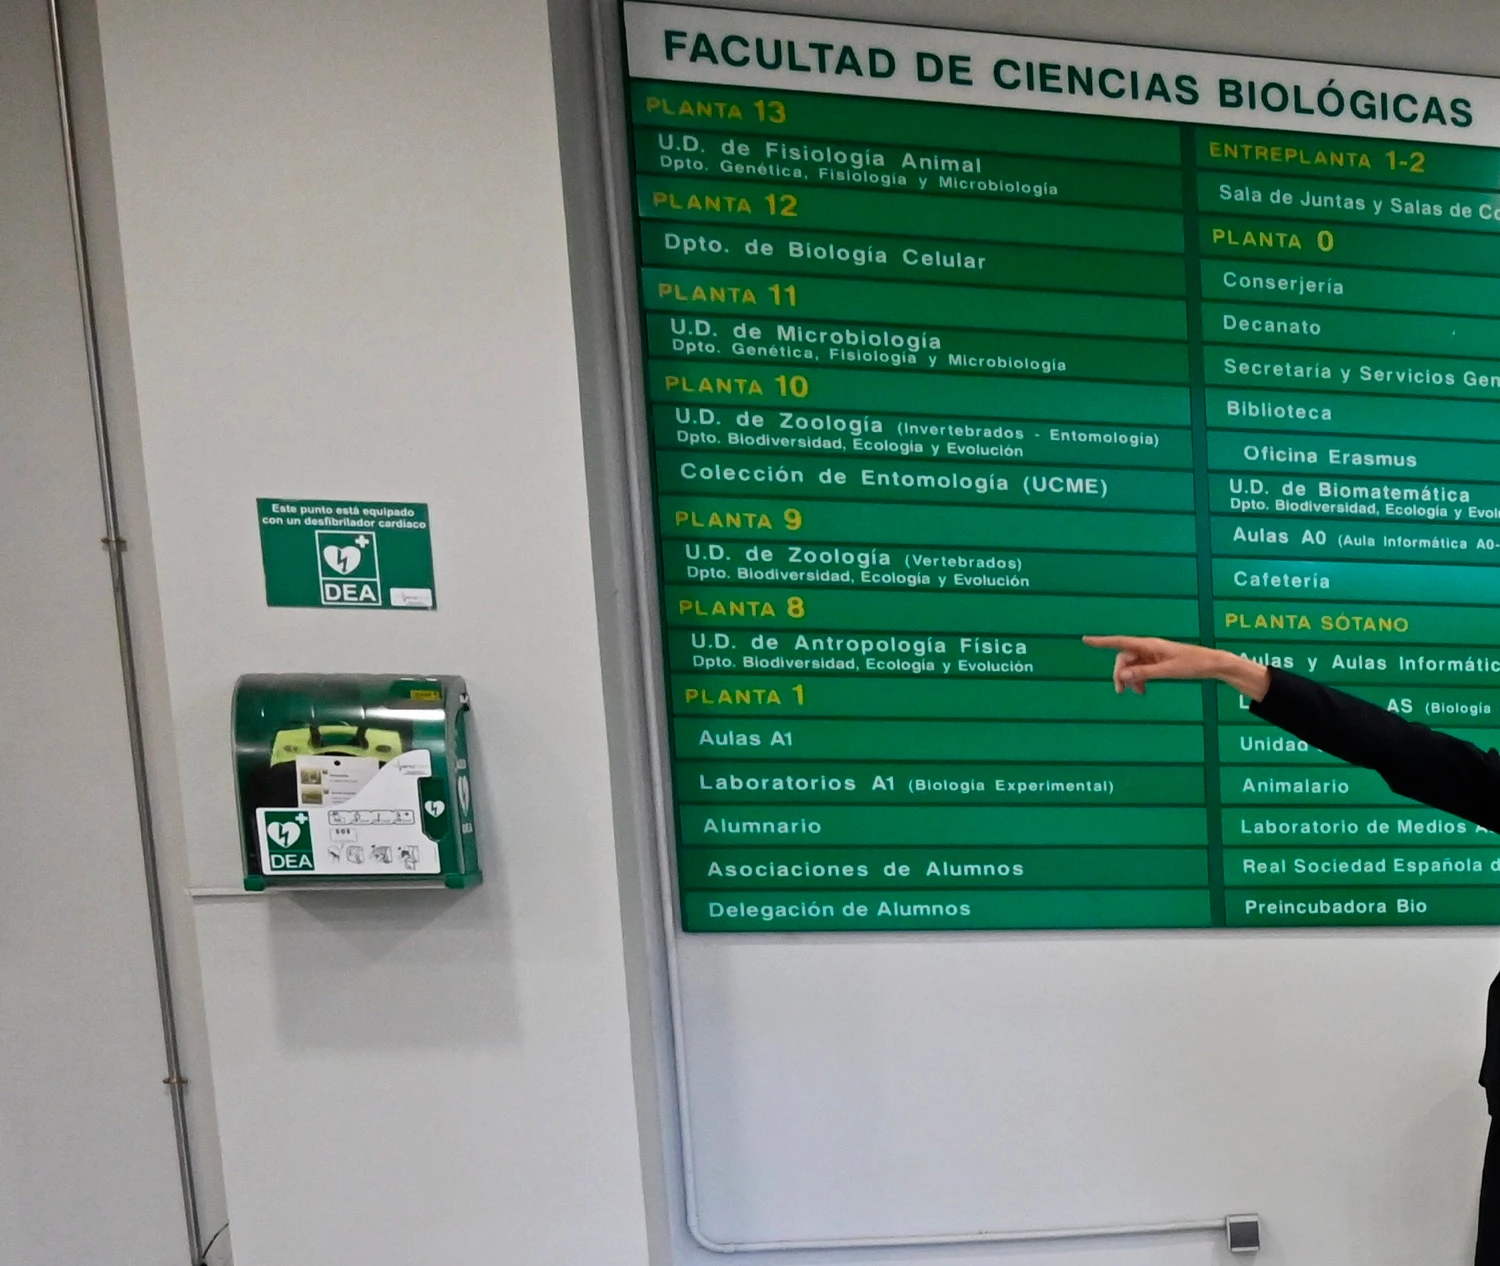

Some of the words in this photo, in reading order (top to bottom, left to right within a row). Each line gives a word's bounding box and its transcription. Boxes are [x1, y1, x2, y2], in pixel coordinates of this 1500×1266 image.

[664, 30, 896, 78] FACULTAD
[917, 52, 973, 86] DE
[994, 58, 1200, 106] CIENCIAS
[1219, 79, 1473, 127] BIOLÓGICAS
[646, 97, 742, 120] PLANTA
[755, 100, 786, 123] 13
[658, 134, 704, 152] U.D.
[721, 139, 750, 156] de
[766, 142, 885, 170] Fisiología
[902, 152, 981, 173] Animal
[1210, 142, 1371, 169] ENTREPLANTA
[1386, 151, 1425, 173] 1-2
[660, 155, 709, 173] Dpto.
[720, 159, 808, 180] Genética,
[819, 167, 906, 187] Fisiología
[919, 177, 927, 189] y
[939, 176, 1057, 197] Microbiología
[665, 234, 728, 255] Dpto.
[745, 239, 773, 255] de
[789, 241, 886, 266] Biología
[903, 249, 986, 269] Celular
[1223, 272, 1344, 295] Conserjería
[659, 283, 756, 303] PLANTA
[769, 284, 796, 307] 11
[1223, 315, 1321, 335] Decanato
[671, 319, 717, 337] U.D.
[734, 322, 762, 340] de
[777, 325, 941, 352] Microbiología
[1224, 359, 1331, 379] Secretaría
[1341, 367, 1350, 383] y
[1360, 366, 1455, 385] Servicios
[1227, 401, 1331, 420] Biblioteca
[676, 408, 720, 425] U.D.
[736, 411, 764, 428] de
[780, 413, 882, 436] Zoología
[897, 422, 1024, 440] (Invertebrados
[1050, 428, 1159, 447] Entomología)
[1244, 445, 1317, 463] Oficina
[1329, 449, 1417, 468] Erasmus
[680, 462, 804, 482] Colección
[819, 468, 846, 484] de
[862, 469, 1008, 493] Entomología
[1023, 476, 1107, 497] (UCME)
[272, 504, 296, 513] Este
[301, 506, 332, 516] punto
[336, 506, 359, 515] está
[363, 507, 414, 518] equipado
[262, 517, 283, 525] con
[287, 516, 300, 525] un
[305, 516, 374, 528] desfibrilador
[1233, 527, 1289, 544] Aulas
[1302, 530, 1326, 545] A0
[1338, 534, 1375, 549] (Aula
[1383, 535, 1467, 550] Informática
[1234, 571, 1330, 589] Cafetería
[325, 584, 376, 602] DEA
[1226, 613, 1311, 630] PLANTA
[1321, 613, 1408, 633] SÓTANO
[691, 633, 736, 649] U.D.
[751, 634, 778, 650] de
[795, 635, 946, 656] Antropología
[960, 638, 1027, 655] Física
[693, 656, 737, 670] Dpto.
[743, 656, 860, 671] Biodiversidad,
[866, 658, 935, 674] Ecología
[943, 662, 950, 673] y
[959, 659, 1033, 673] Evolución
[685, 688, 781, 705] PLANTA
[792, 685, 804, 705] 1
[700, 730, 761, 746] Aulas
[771, 731, 792, 746] A1
[700, 775, 856, 791] Laboratorios
[872, 775, 894, 790] A1
[909, 779, 985, 794] (Biología
[995, 779, 1114, 794] Experimental)
[1242, 777, 1349, 794] Animalario
[704, 818, 821, 834] Alumnario
[270, 854, 312, 869] DEA
[708, 862, 868, 877] Asociaciones
[884, 861, 910, 876] de
[927, 861, 1023, 876] Alumnos
[709, 901, 834, 920] Delegación
[843, 902, 868, 917] de
[878, 901, 970, 916] Alumnos
[1245, 899, 1386, 914] Preincubadora
[1397, 899, 1427, 913] Bio
